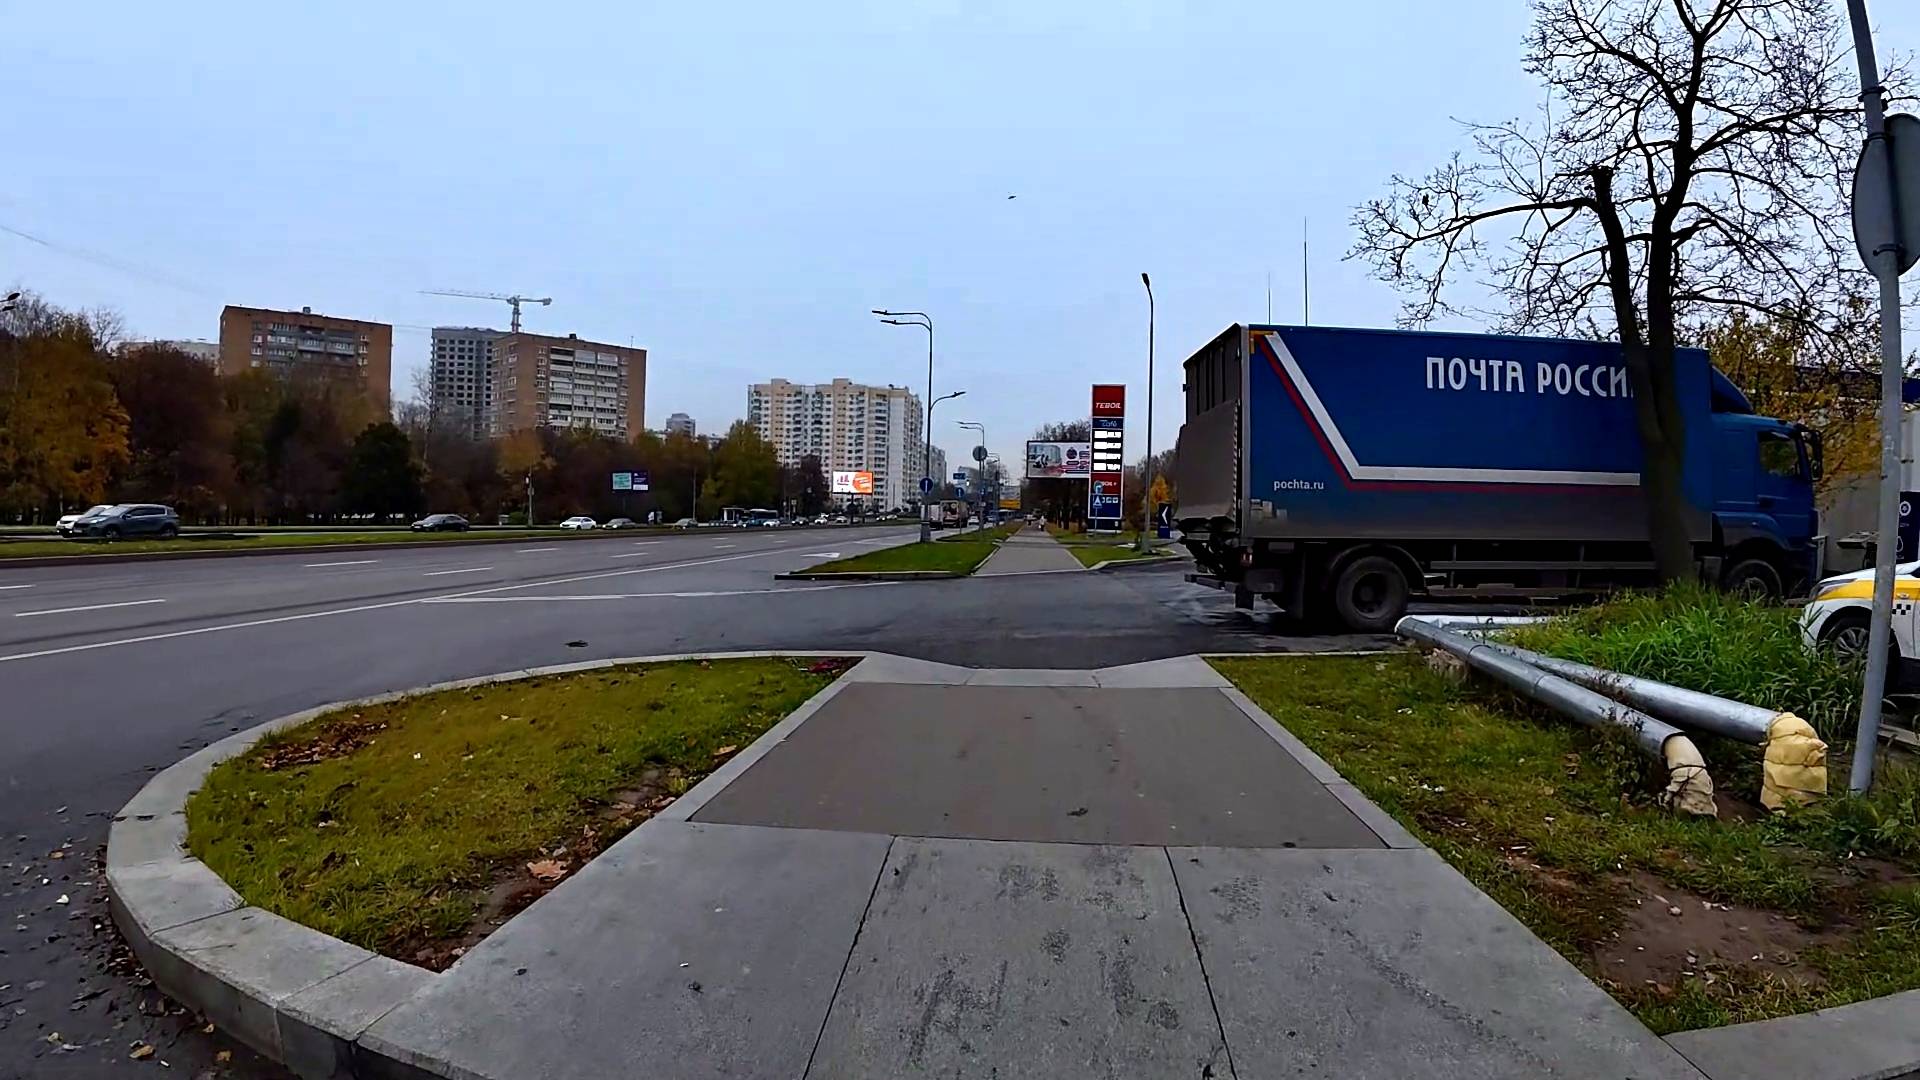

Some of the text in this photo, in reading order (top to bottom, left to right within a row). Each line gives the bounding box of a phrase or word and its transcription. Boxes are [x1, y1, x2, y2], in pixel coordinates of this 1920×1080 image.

[1427, 356, 1634, 399] ПОЧТА РОССИ
[1273, 479, 1324, 491] pochta.ru
